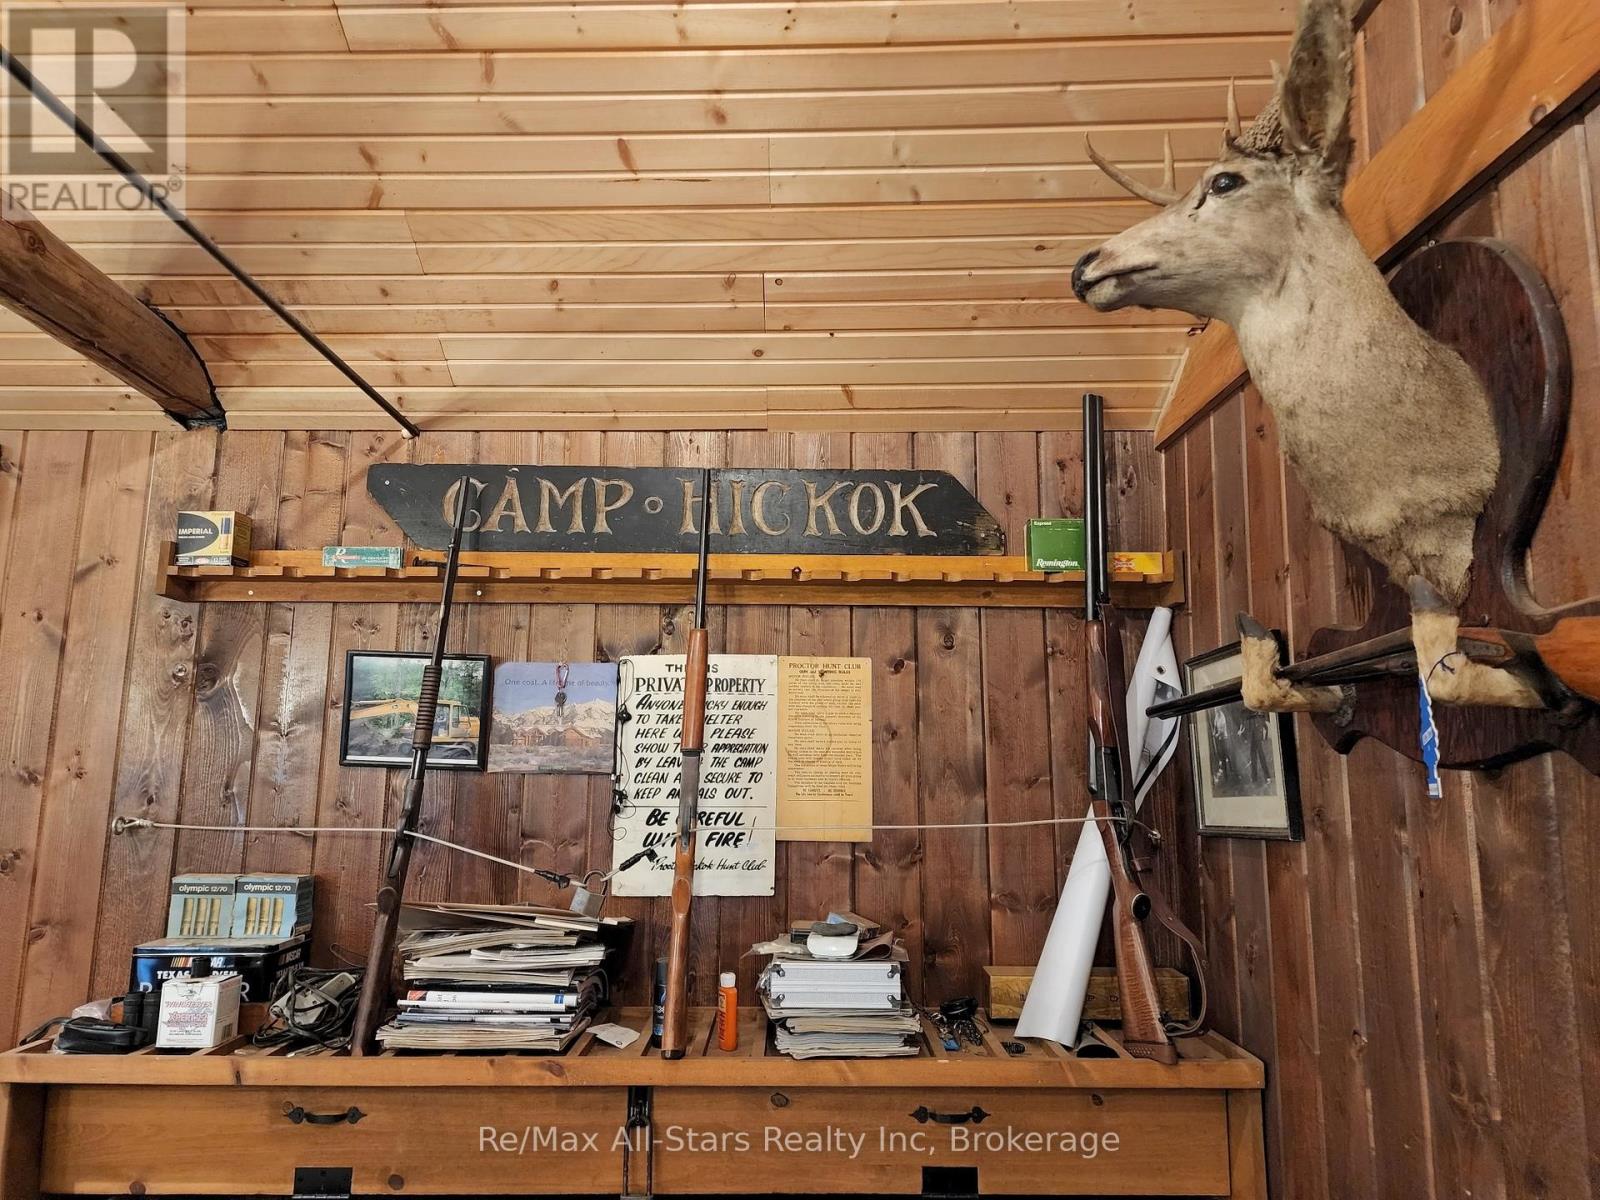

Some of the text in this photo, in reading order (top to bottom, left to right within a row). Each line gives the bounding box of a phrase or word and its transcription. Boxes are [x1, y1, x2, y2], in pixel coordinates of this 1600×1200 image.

[442, 475, 939, 537] CAMP HICKOK
[178, 527, 213, 535] IMPERIAL
[706, 677, 766, 693] PROPERTY
[731, 700, 768, 711] ENOUGH
[636, 714, 650, 724] TO
[656, 713, 683, 725] TAKE
[635, 727, 670, 739] HERE
[710, 727, 758, 739] PLEASE
[634, 742, 669, 754] SHOW
[711, 742, 769, 754] APPRECIATION
[635, 756, 653, 769] BY
[710, 756, 729, 768] THE
[733, 756, 763, 769] CAMP
[634, 771, 669, 784] CLEAN
[704, 771, 742, 784] SECURE
[749, 771, 763, 783] TO
[634, 787, 661, 800] KEEP
[646, 808, 670, 827] BE
[179, 884, 209, 893] olympic
[243, 883, 273, 892] olympic
